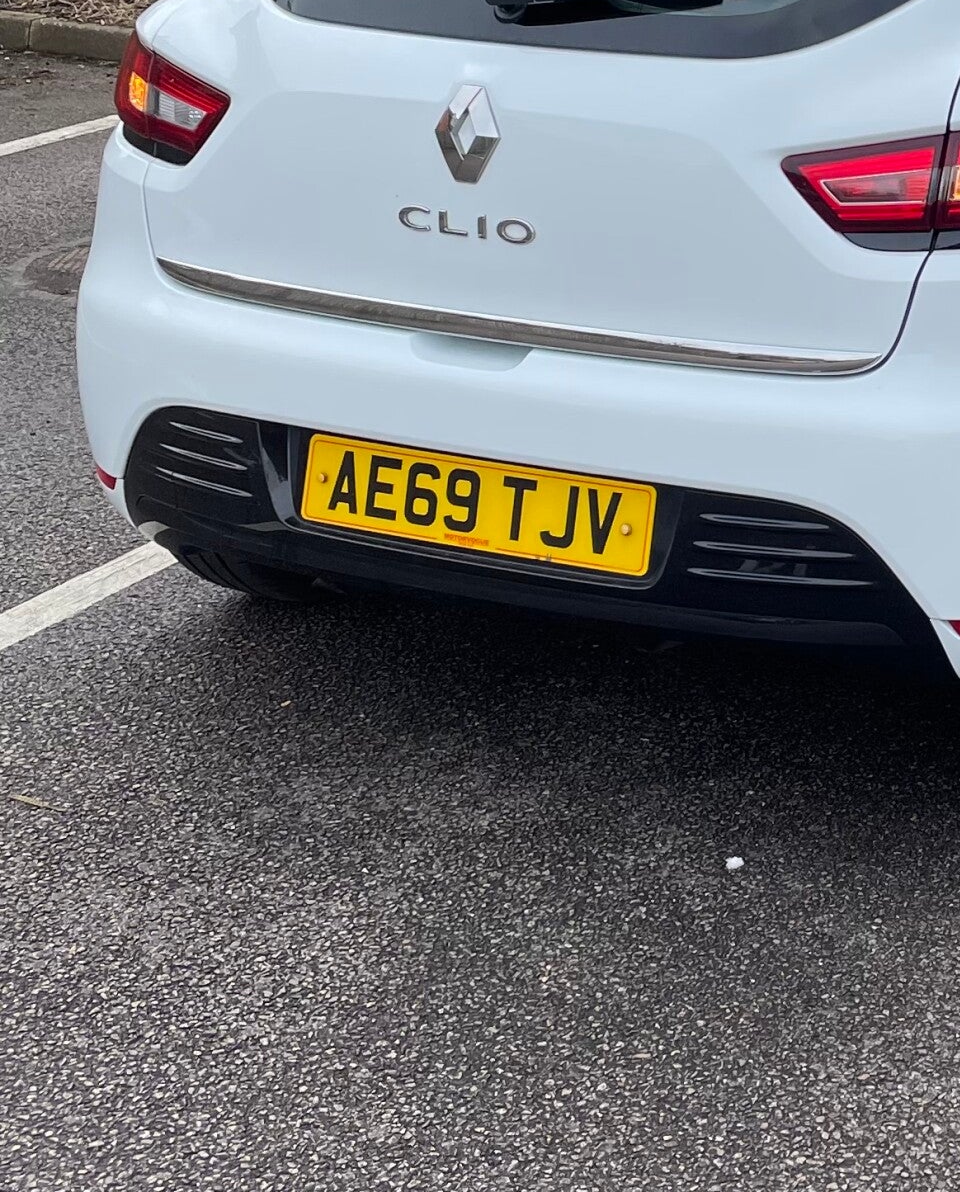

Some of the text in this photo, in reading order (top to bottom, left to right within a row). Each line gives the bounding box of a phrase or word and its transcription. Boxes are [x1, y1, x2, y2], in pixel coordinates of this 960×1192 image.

[398, 204, 537, 245] CLIO
[328, 450, 623, 555] AE69 TJV
